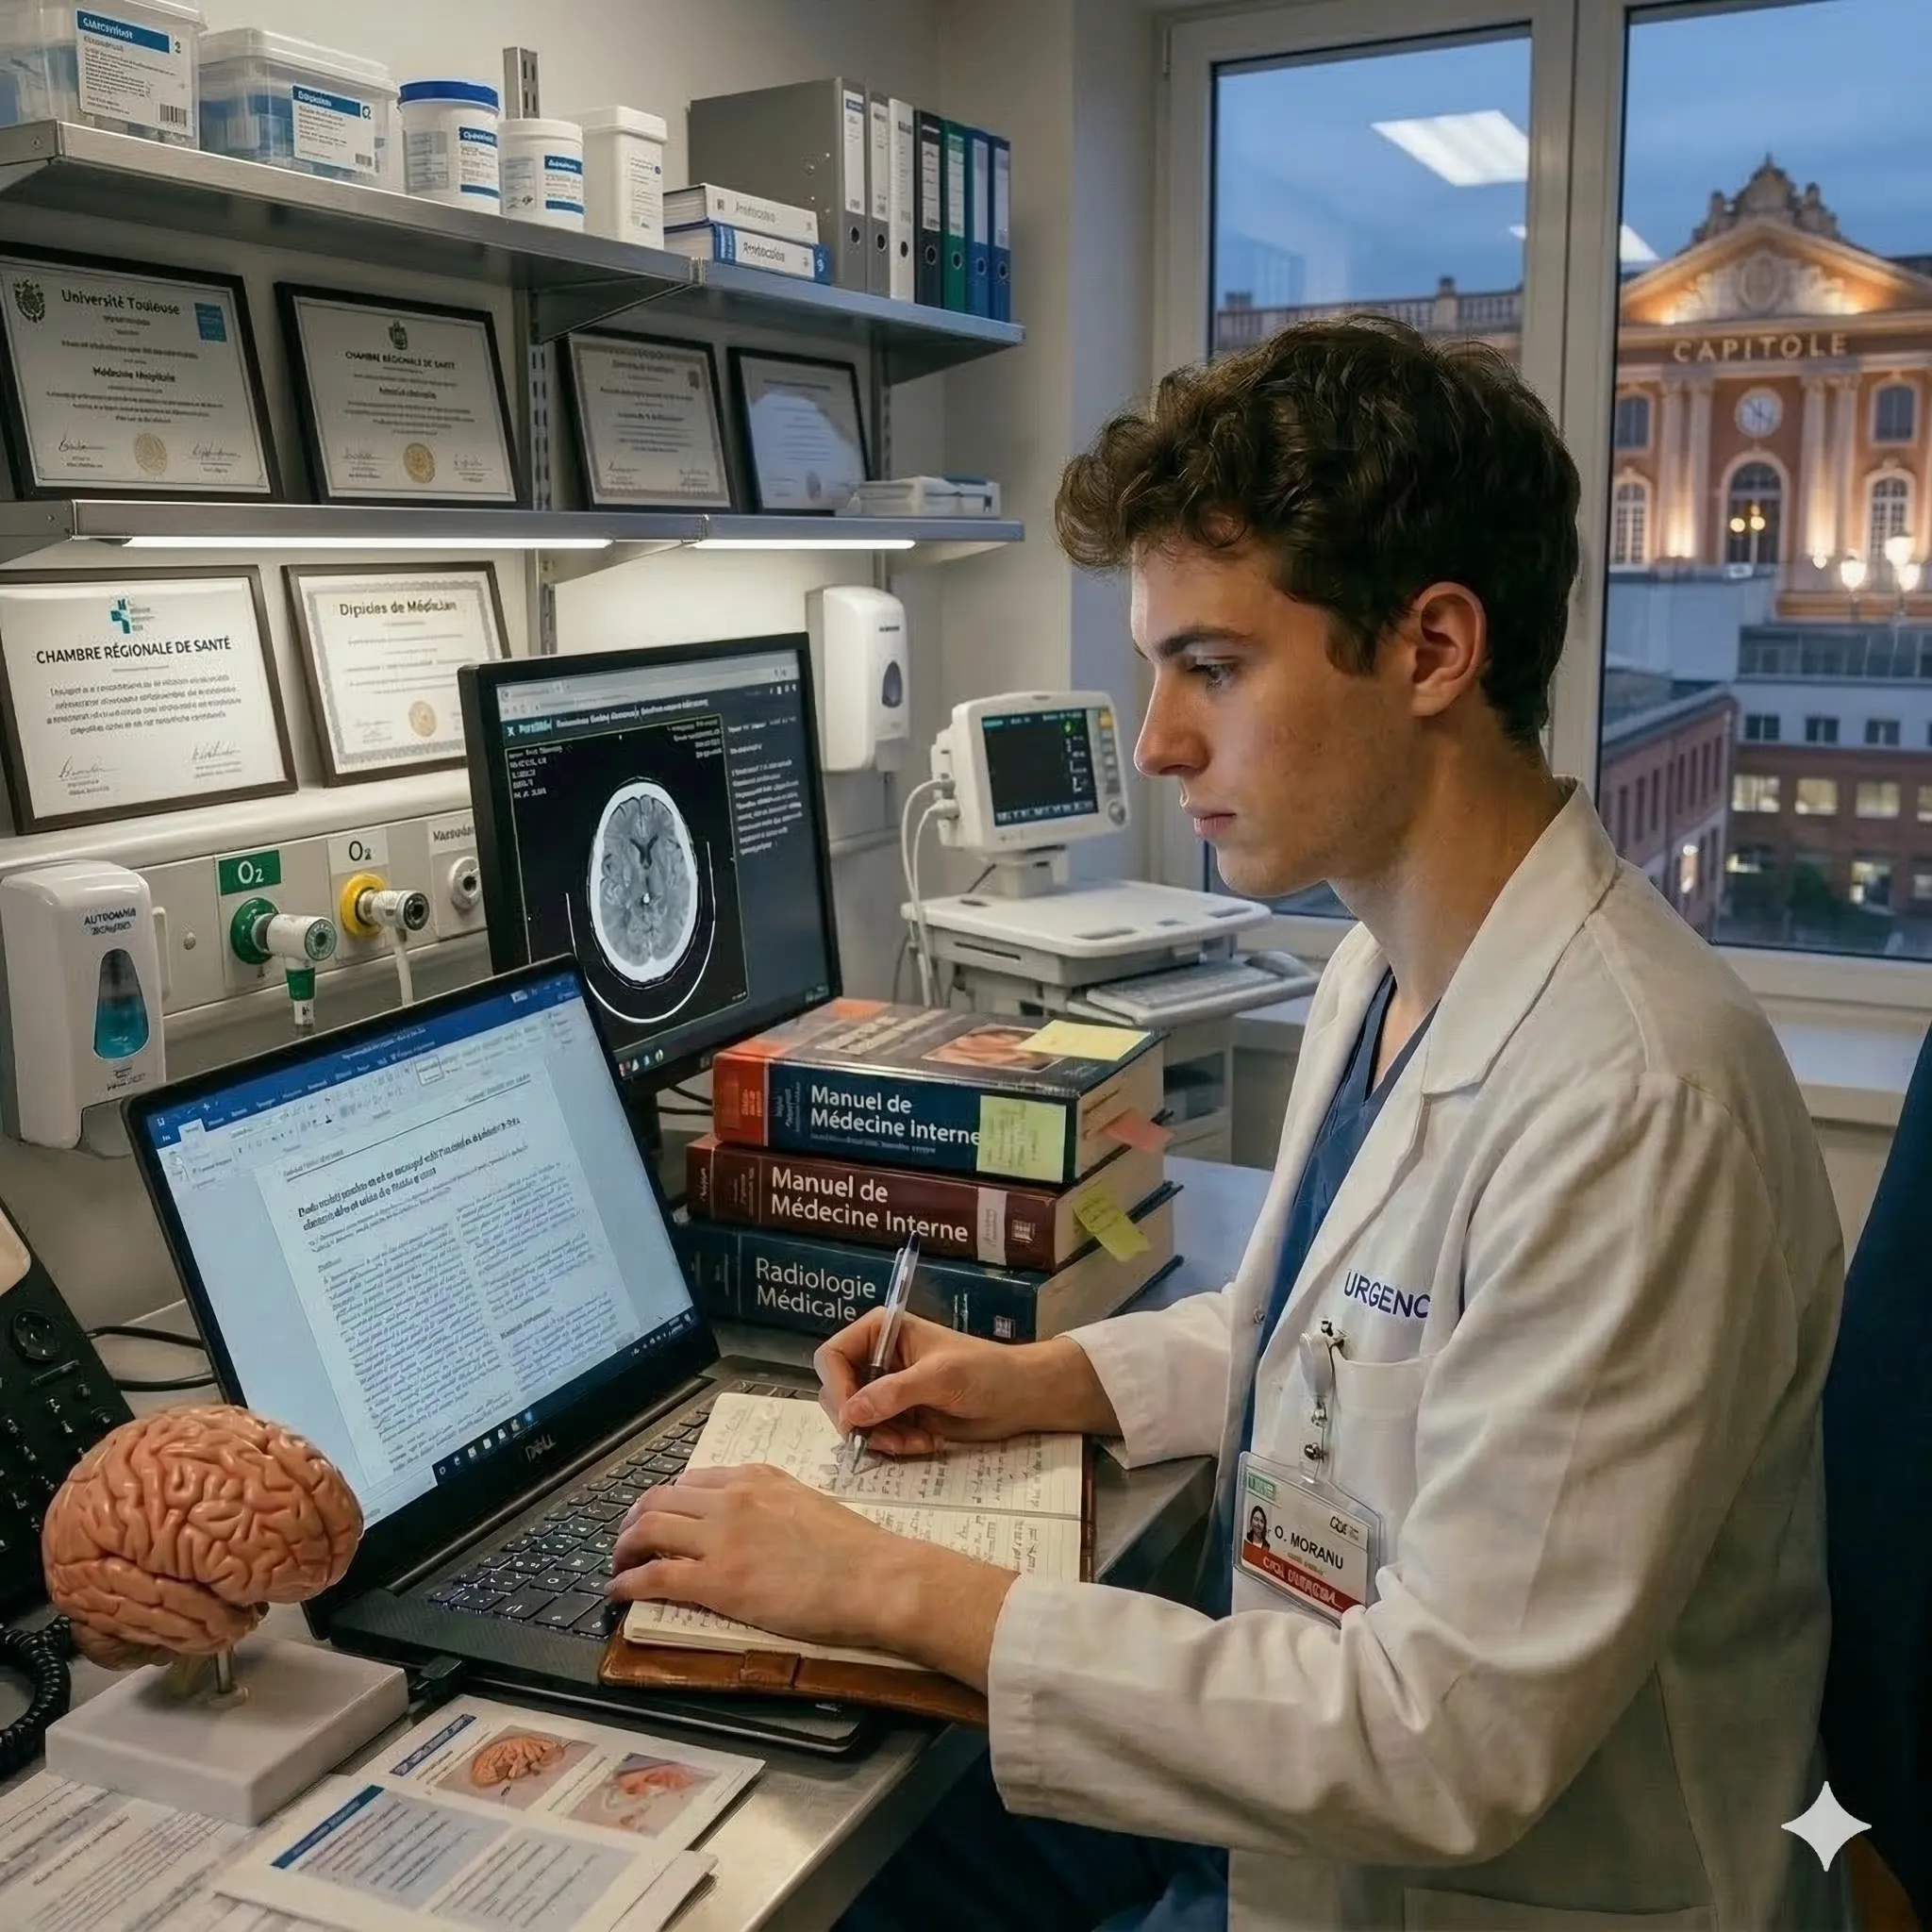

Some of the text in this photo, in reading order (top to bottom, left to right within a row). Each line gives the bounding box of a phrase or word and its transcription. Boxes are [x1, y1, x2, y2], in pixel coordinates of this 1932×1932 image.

[1673, 332, 1846, 363] CAPITOLE
[391, 601, 405, 613] de
[36, 636, 232, 664] CHAMBRE RÉGIONALE DE SANTÉ
[811, 1085, 912, 1114] Manuel de
[810, 1108, 906, 1137] Médecine
[772, 1166, 889, 1203] Manuel de
[772, 1193, 969, 1242] Médecine Interne
[756, 1257, 876, 1300] Radiologie
[1344, 1271, 1431, 1318] URGENC
[757, 1285, 857, 1322] Médicale
[1274, 1524, 1343, 1571] O. MORANU
